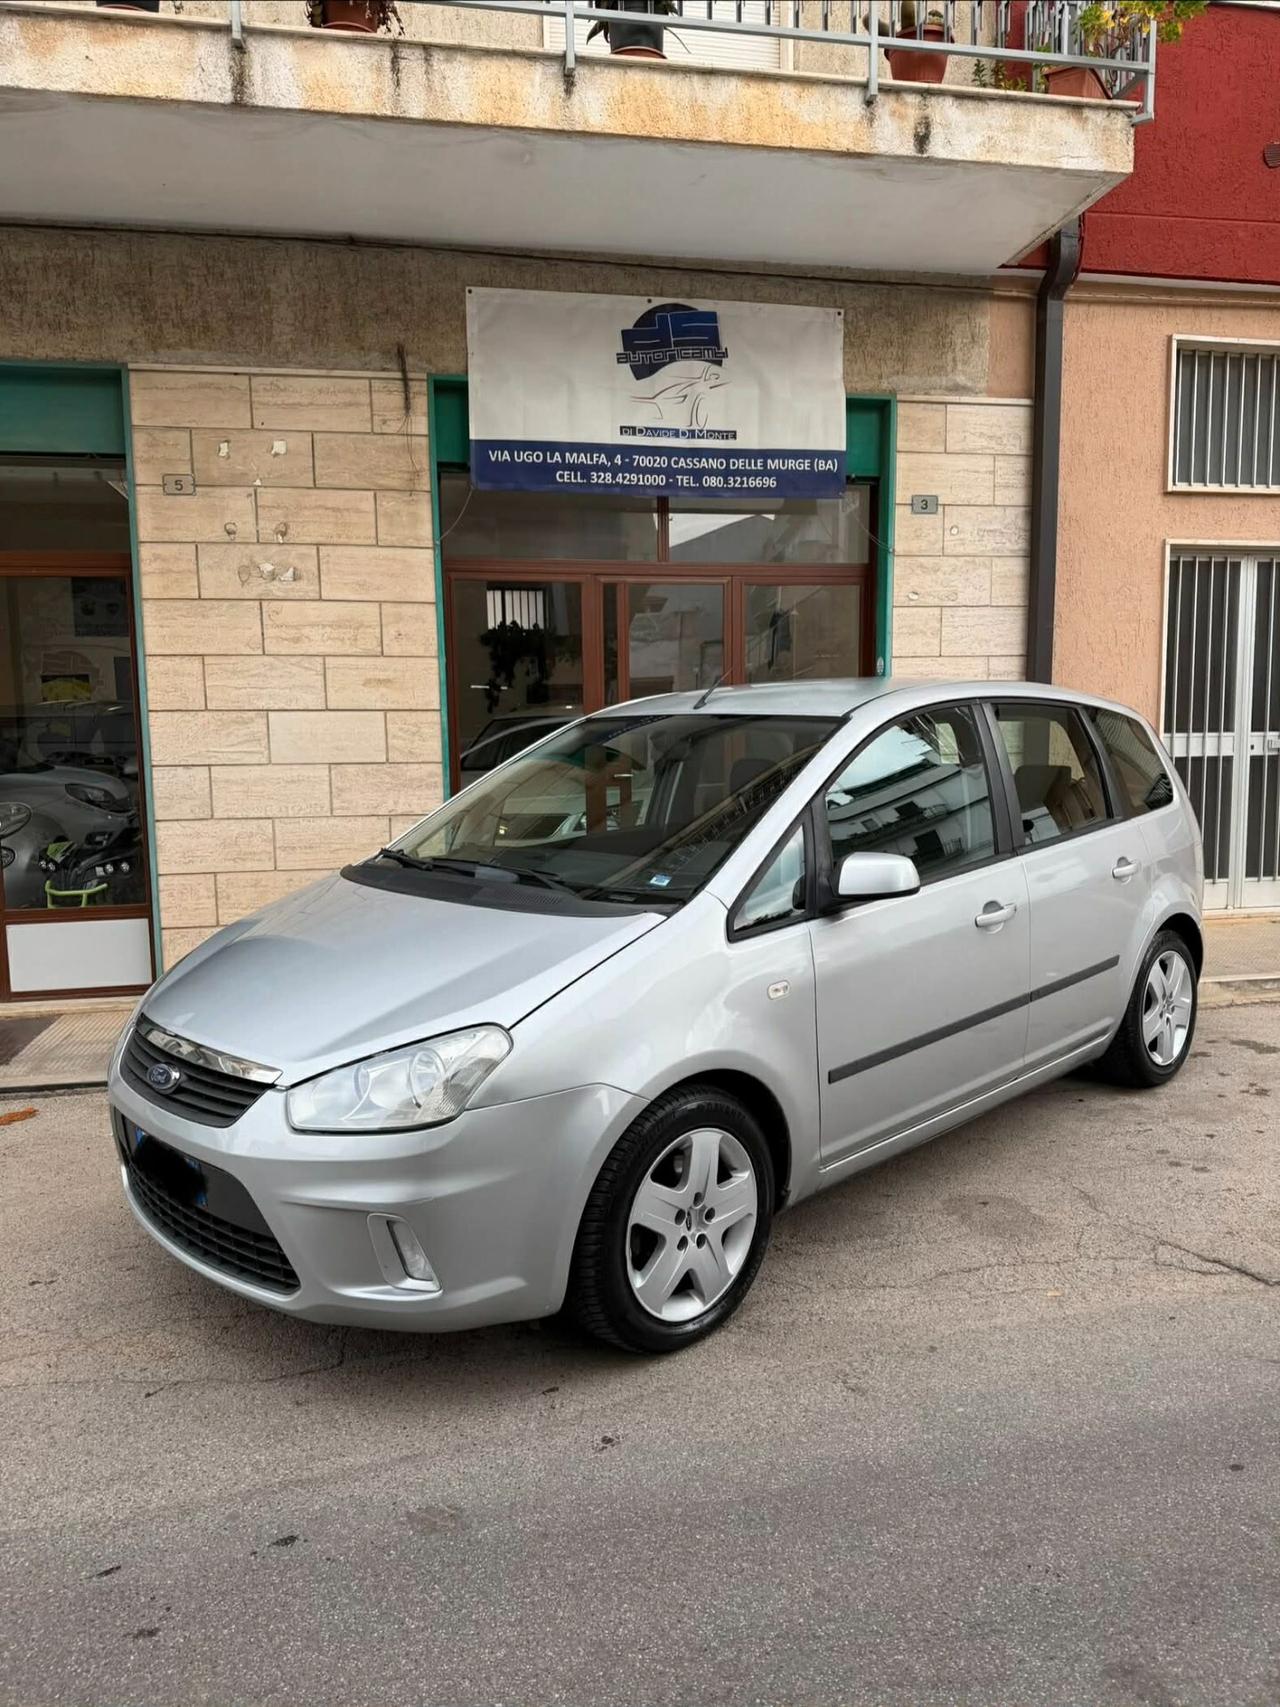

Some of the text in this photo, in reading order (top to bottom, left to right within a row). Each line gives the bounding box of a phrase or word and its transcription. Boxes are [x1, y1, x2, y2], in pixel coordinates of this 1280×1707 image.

[489, 450, 511, 462] VIA
[514, 450, 543, 463] UGO
[546, 451, 562, 463] LA
[565, 452, 611, 466] MALFA,
[614, 454, 622, 465] 4
[633, 455, 668, 468] 70020
[671, 456, 726, 469] CASSANO
[729, 458, 764, 470] DELLE
[767, 458, 811, 471] MURGE
[814, 458, 838, 473] (BA)
[174, 479, 184, 491] 5
[555, 470, 586, 483] CELL.
[590, 472, 666, 486] 328.4291000
[676, 475, 699, 487] TEL.
[702, 475, 777, 488] 080.3216696
[920, 498, 929, 510] 3
